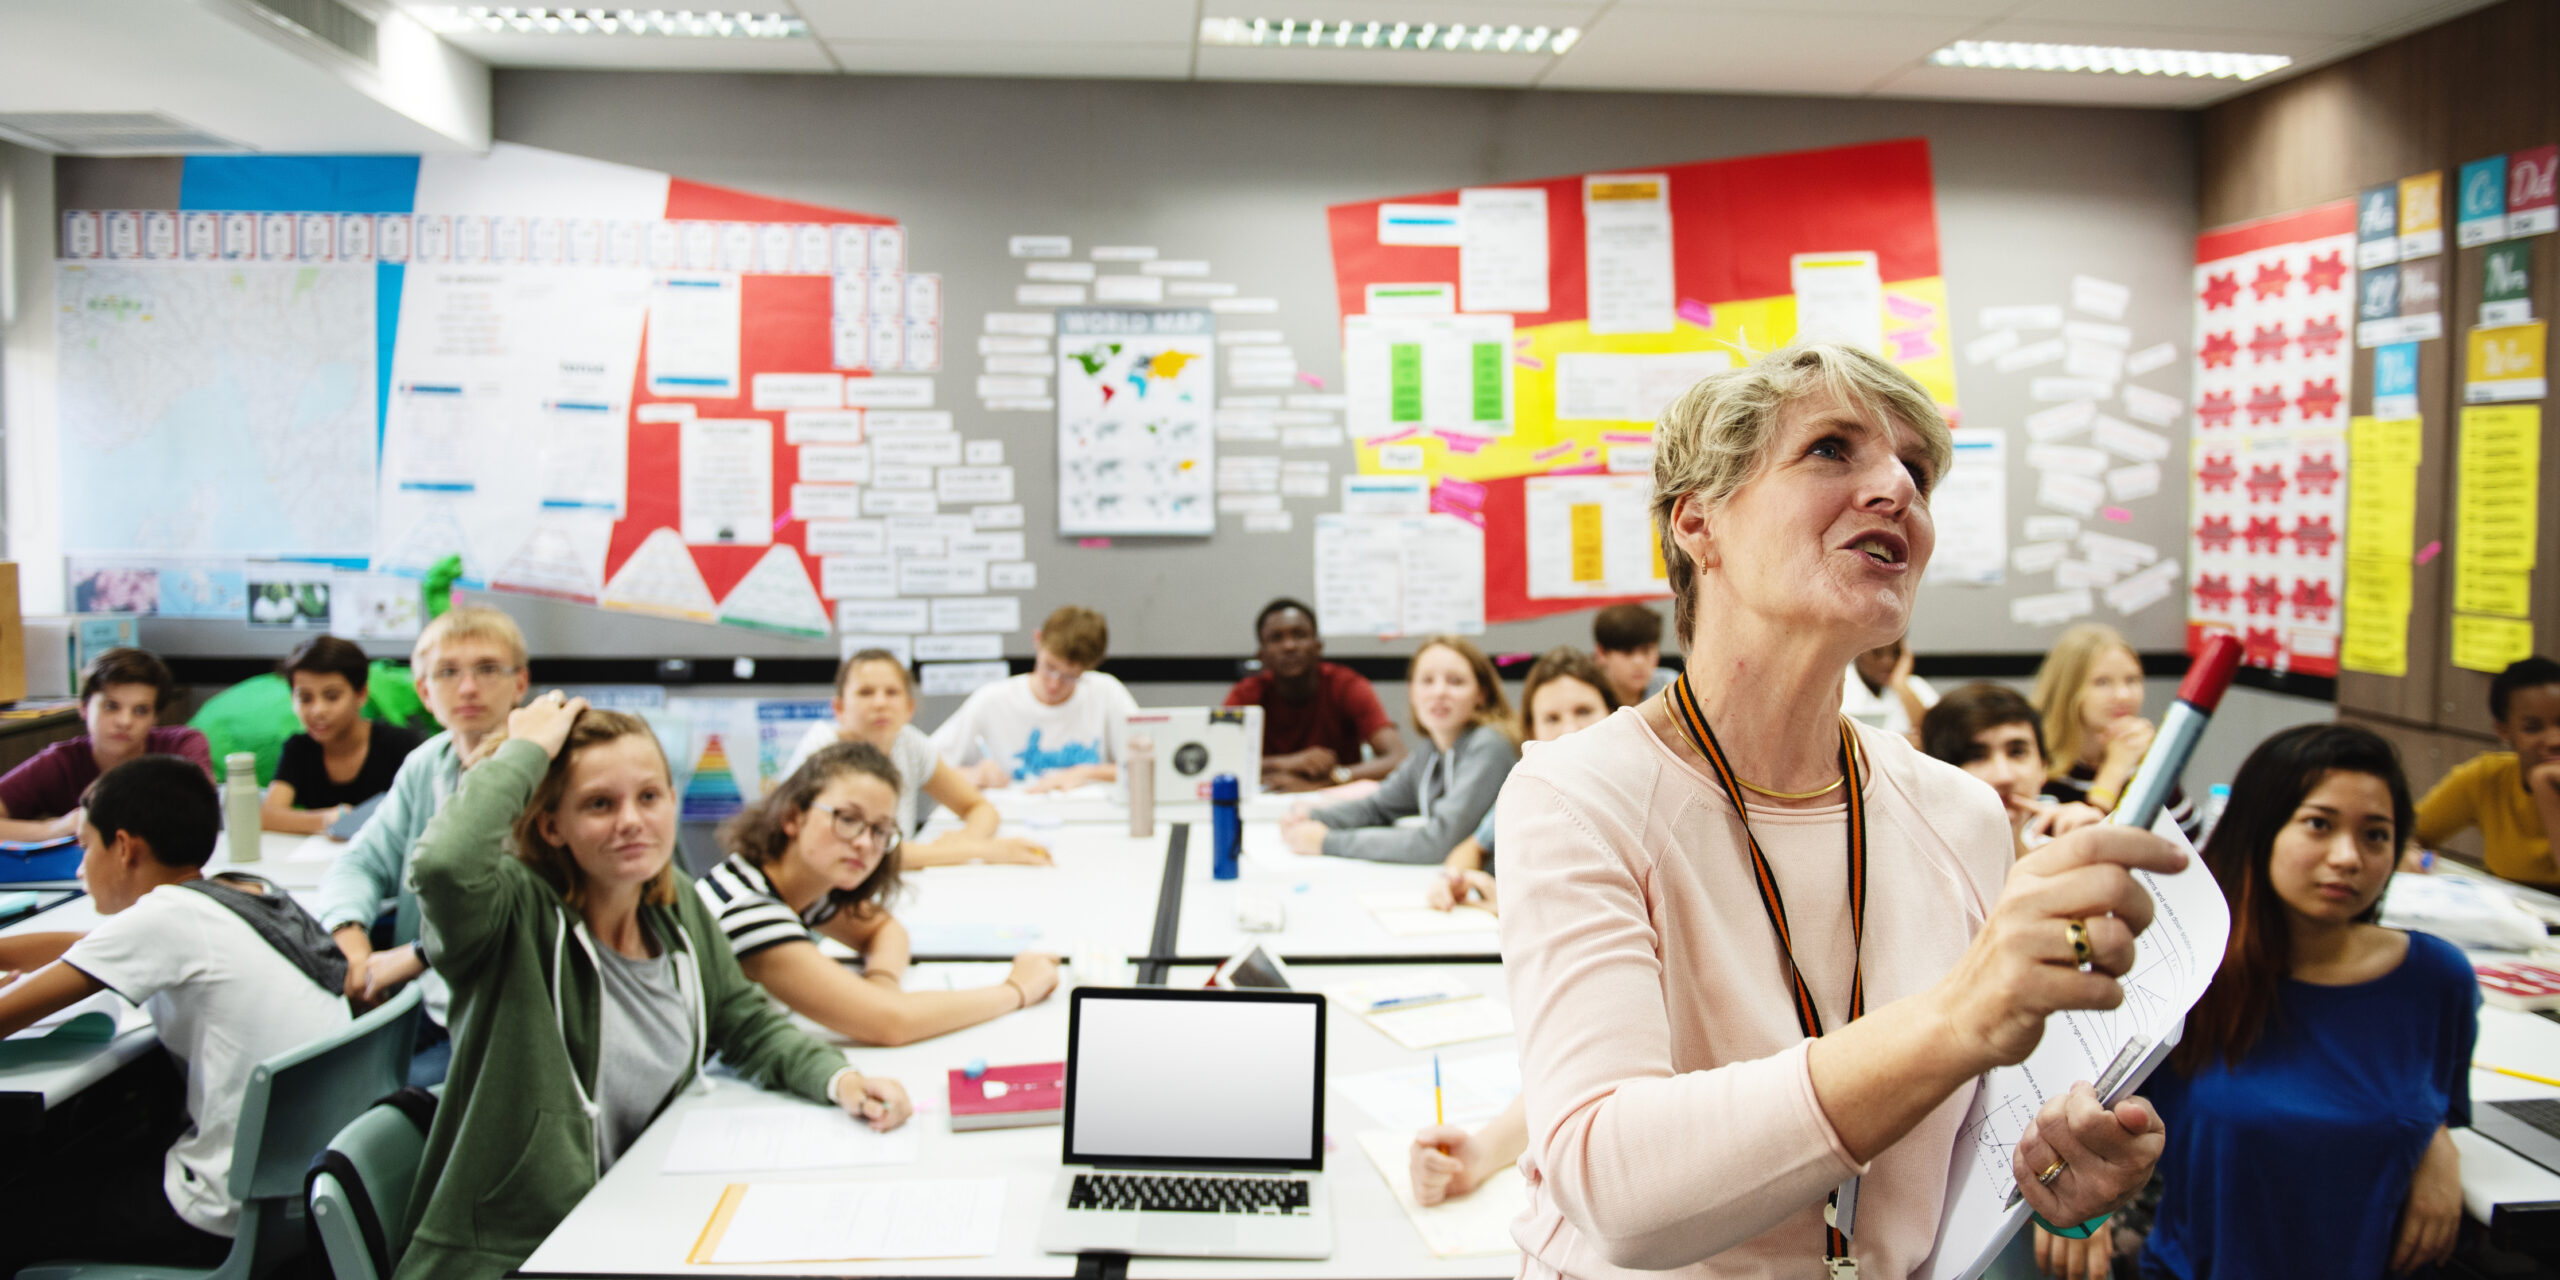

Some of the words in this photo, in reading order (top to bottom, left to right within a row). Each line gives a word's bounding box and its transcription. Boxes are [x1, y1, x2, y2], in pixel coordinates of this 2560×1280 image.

[1065, 311, 1149, 332] WORLD
[1153, 311, 1205, 332] MAP
[2155, 891, 2166, 903] and
[2072, 1024, 2082, 1038] high
[2080, 1037, 2092, 1056] school
